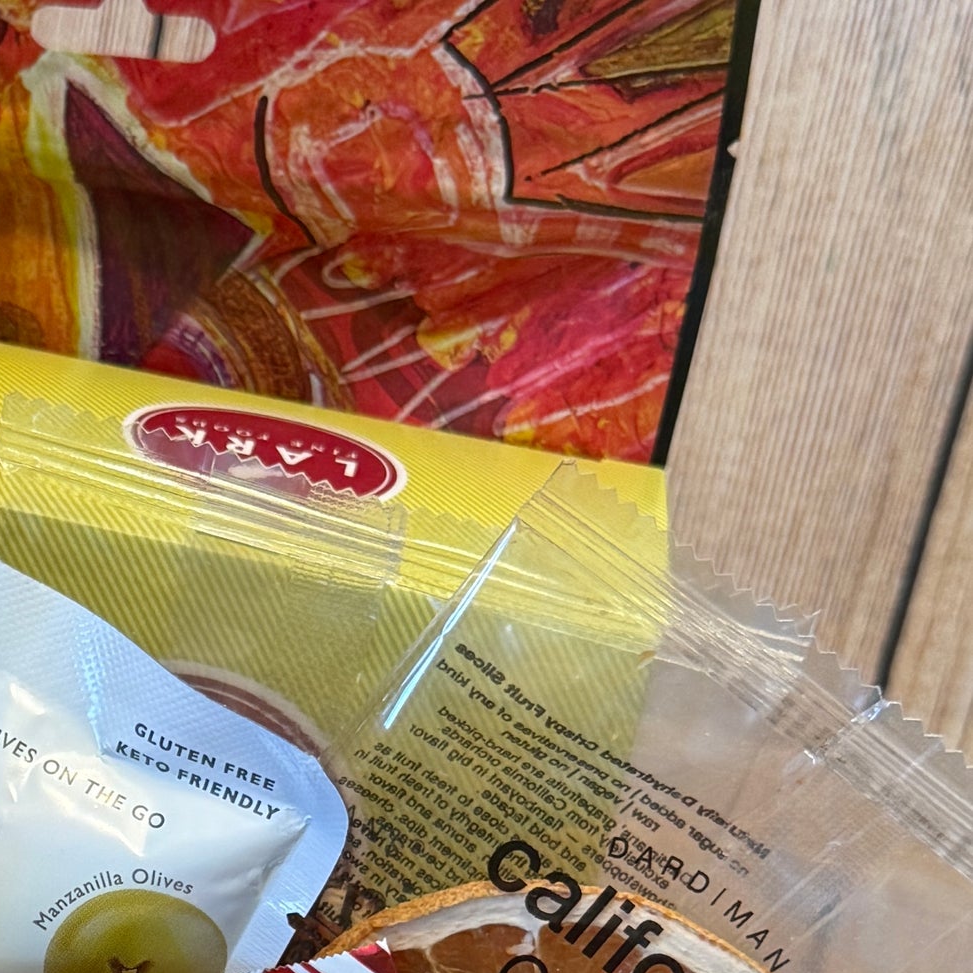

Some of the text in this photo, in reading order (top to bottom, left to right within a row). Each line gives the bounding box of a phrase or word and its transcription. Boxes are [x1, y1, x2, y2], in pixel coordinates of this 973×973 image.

[116, 740, 281, 821] KETO FRIENDLY
[134, 723, 276, 792] GLUTEN FREE
[42, 759, 78, 786] ON
[87, 779, 127, 811] THE
[132, 804, 166, 829] GO
[32, 868, 194, 931] Manzanilla Olives
